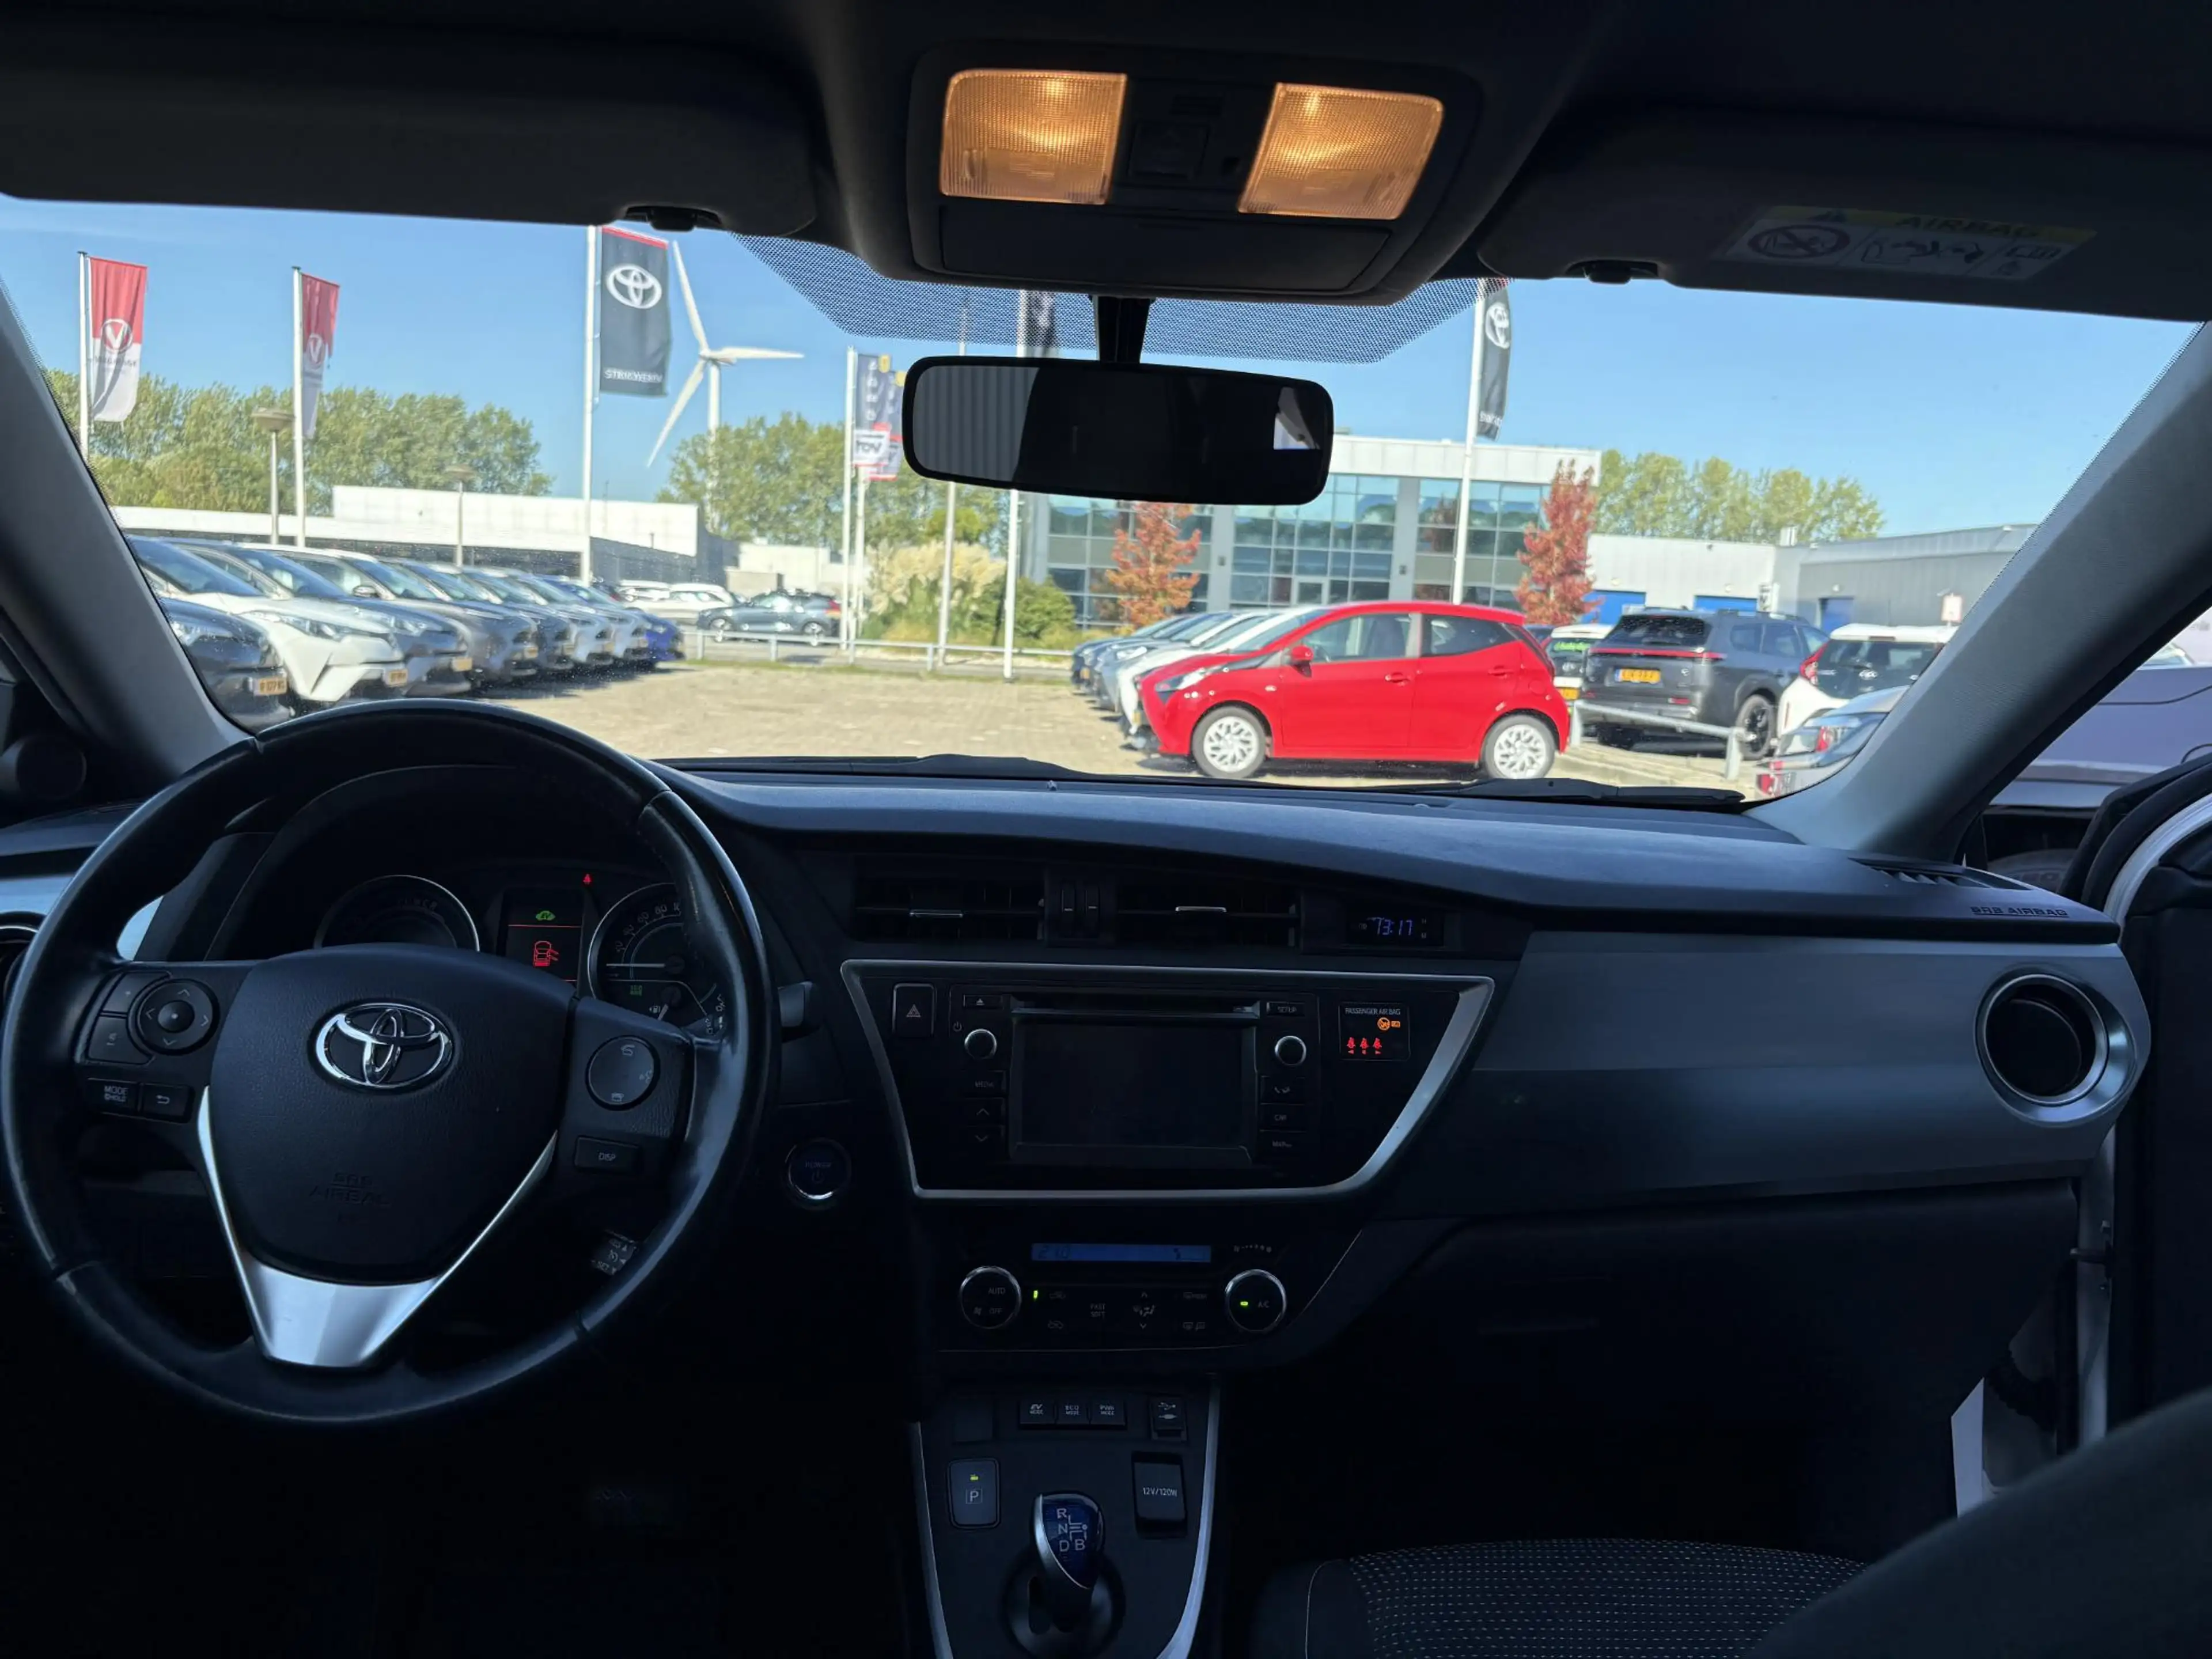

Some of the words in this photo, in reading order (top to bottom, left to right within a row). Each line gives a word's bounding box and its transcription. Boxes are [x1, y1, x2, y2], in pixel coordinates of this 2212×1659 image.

[2008, 907, 2068, 916] AIRBAG
[1344, 1007, 1378, 1015] PASSENGER
[104, 1085, 129, 1093] MODE
[599, 1152, 616, 1162] DISP
[988, 1287, 1006, 1296] AUTO
[1142, 1486, 1177, 1498] 12V/120W
[1056, 1508, 1067, 1519] R
[1058, 1524, 1069, 1535] N
[1059, 1540, 1070, 1552] D
[1074, 1539, 1086, 1551] B
